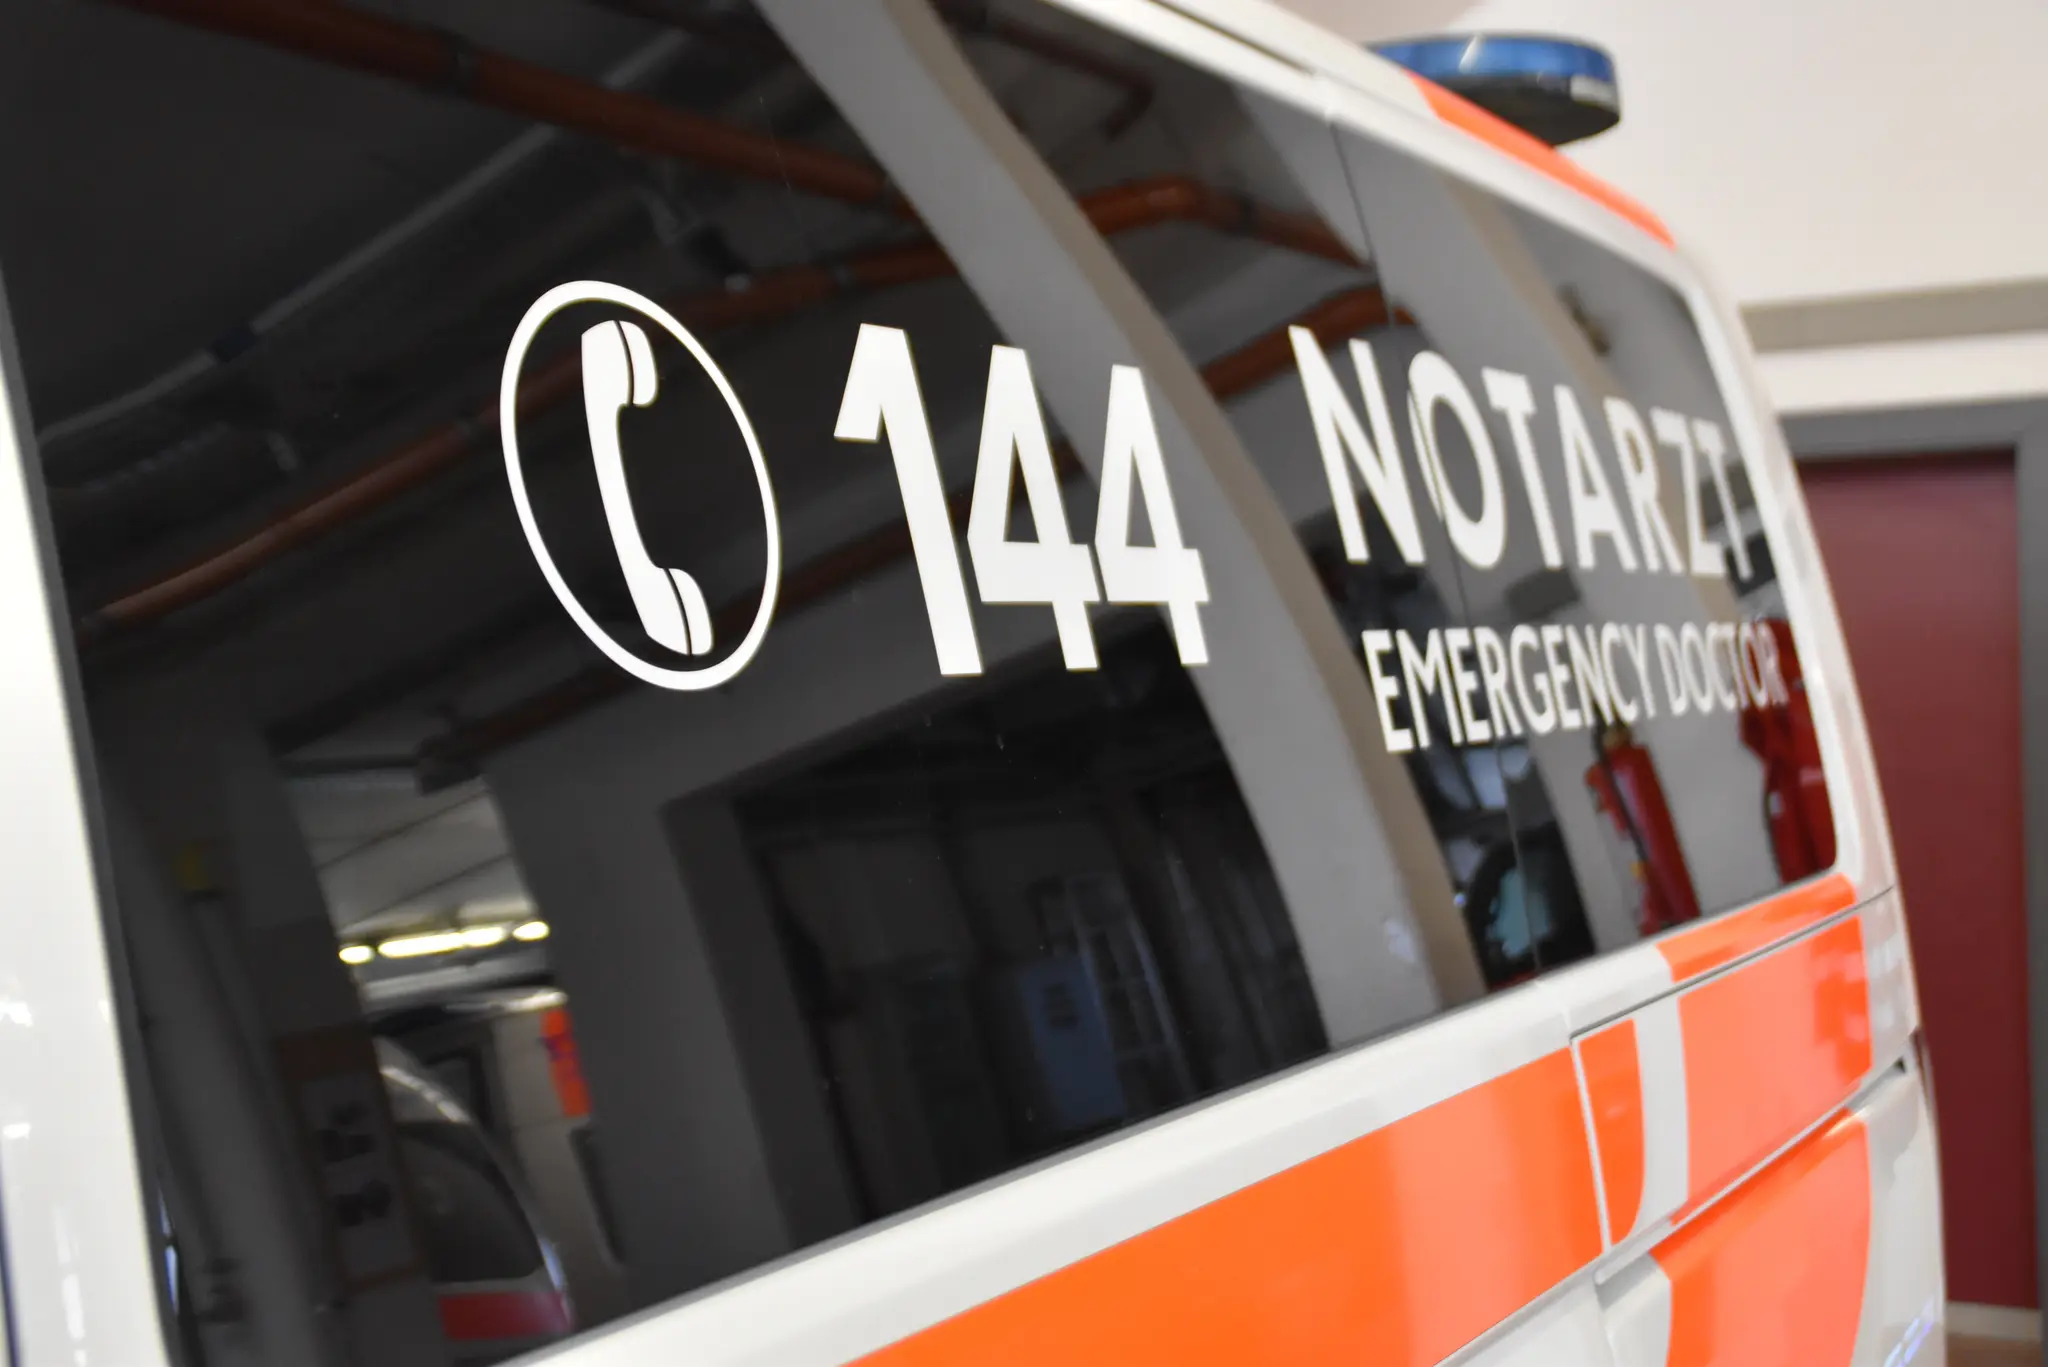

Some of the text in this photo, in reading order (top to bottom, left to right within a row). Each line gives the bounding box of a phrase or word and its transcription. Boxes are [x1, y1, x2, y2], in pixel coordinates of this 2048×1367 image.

[834, 323, 1209, 675] 144
[1289, 324, 1754, 579] NOTARZT
[1362, 622, 1788, 752] EMERGENCY DOCTOR
